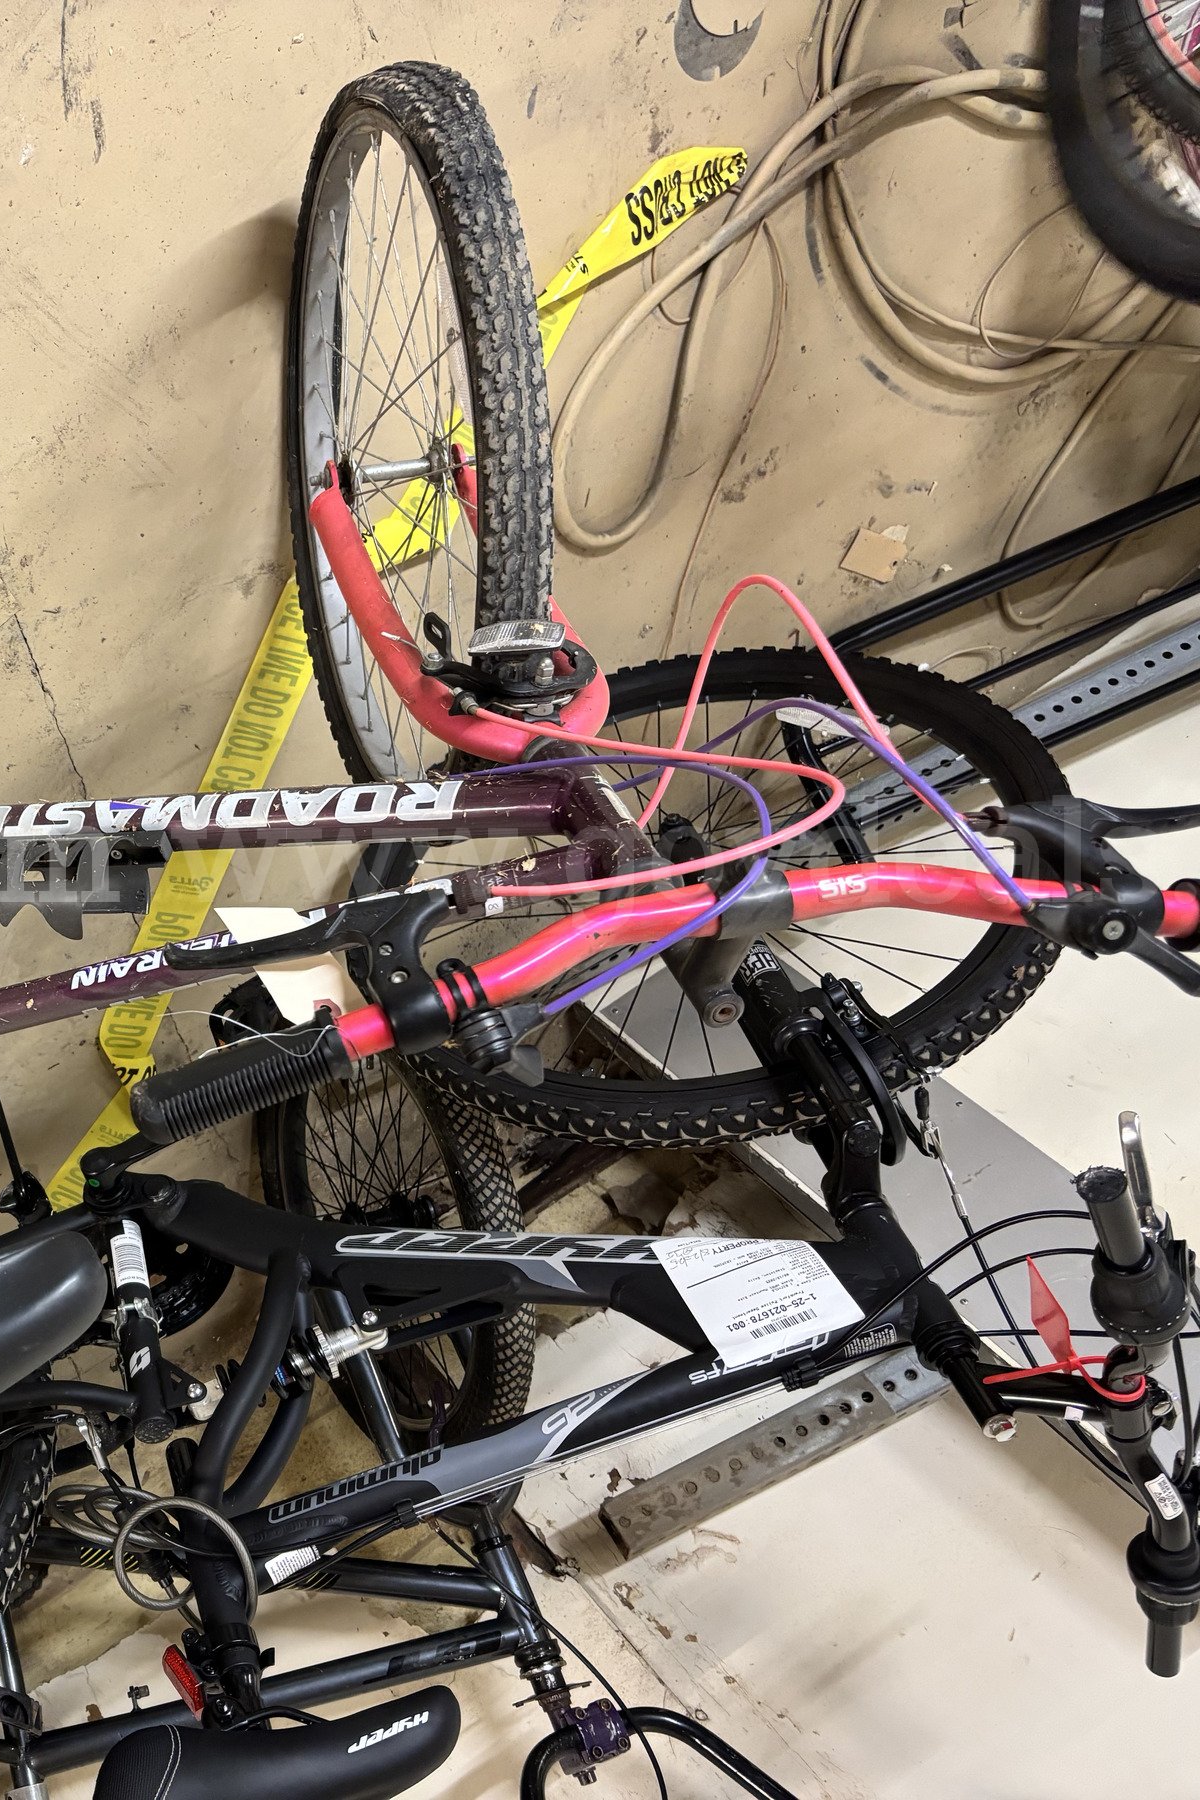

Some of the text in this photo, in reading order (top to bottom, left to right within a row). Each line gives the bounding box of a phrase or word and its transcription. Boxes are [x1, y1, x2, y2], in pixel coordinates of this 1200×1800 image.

[818, 874, 867, 899] SIS
[726, 1293, 818, 1332] 1-25-021678:001
[268, 1447, 443, 1523] aluminum
